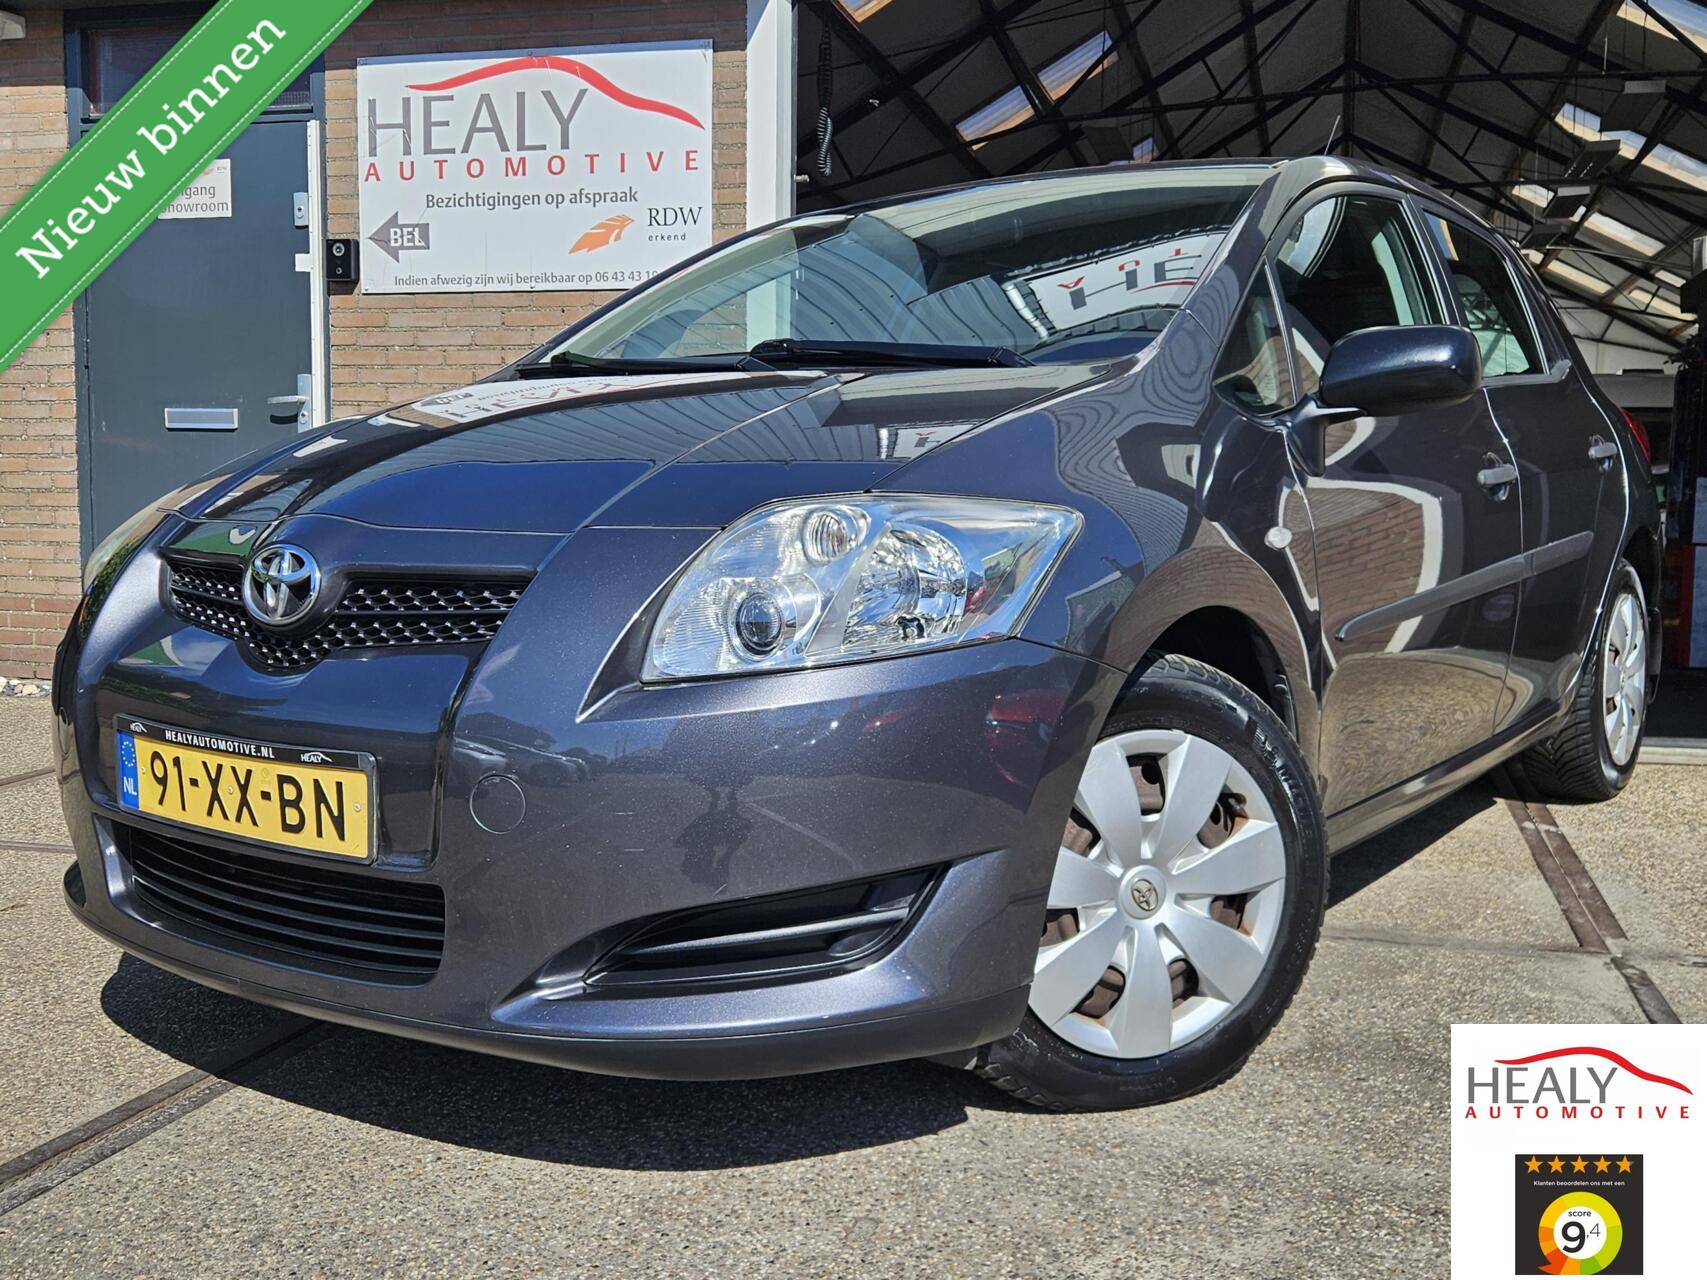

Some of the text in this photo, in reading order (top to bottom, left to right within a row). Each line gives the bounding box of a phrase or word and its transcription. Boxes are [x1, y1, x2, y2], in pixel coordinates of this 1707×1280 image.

[367, 88, 589, 157] HEALY
[364, 149, 700, 182] AUTOMOTIVE
[180, 185, 216, 199] gang
[426, 186, 639, 210] Bezichtigingen op afspraak
[647, 206, 703, 227] RDW
[389, 227, 425, 247] BEL
[647, 232, 687, 241] erkend
[394, 274, 428, 286] Indien
[430, 274, 473, 287] afwezig
[474, 274, 494, 287] zijn
[496, 273, 513, 286] wij
[516, 272, 576, 284] bereikbaar
[578, 274, 593, 285] op
[595, 271, 609, 282] 06
[611, 271, 625, 282] 43
[628, 270, 642, 281] 43
[165, 729, 275, 759] HEALYAUTOMOTIVE.NL
[123, 777, 138, 796] NL
[150, 750, 346, 841] 91-XX-BN
